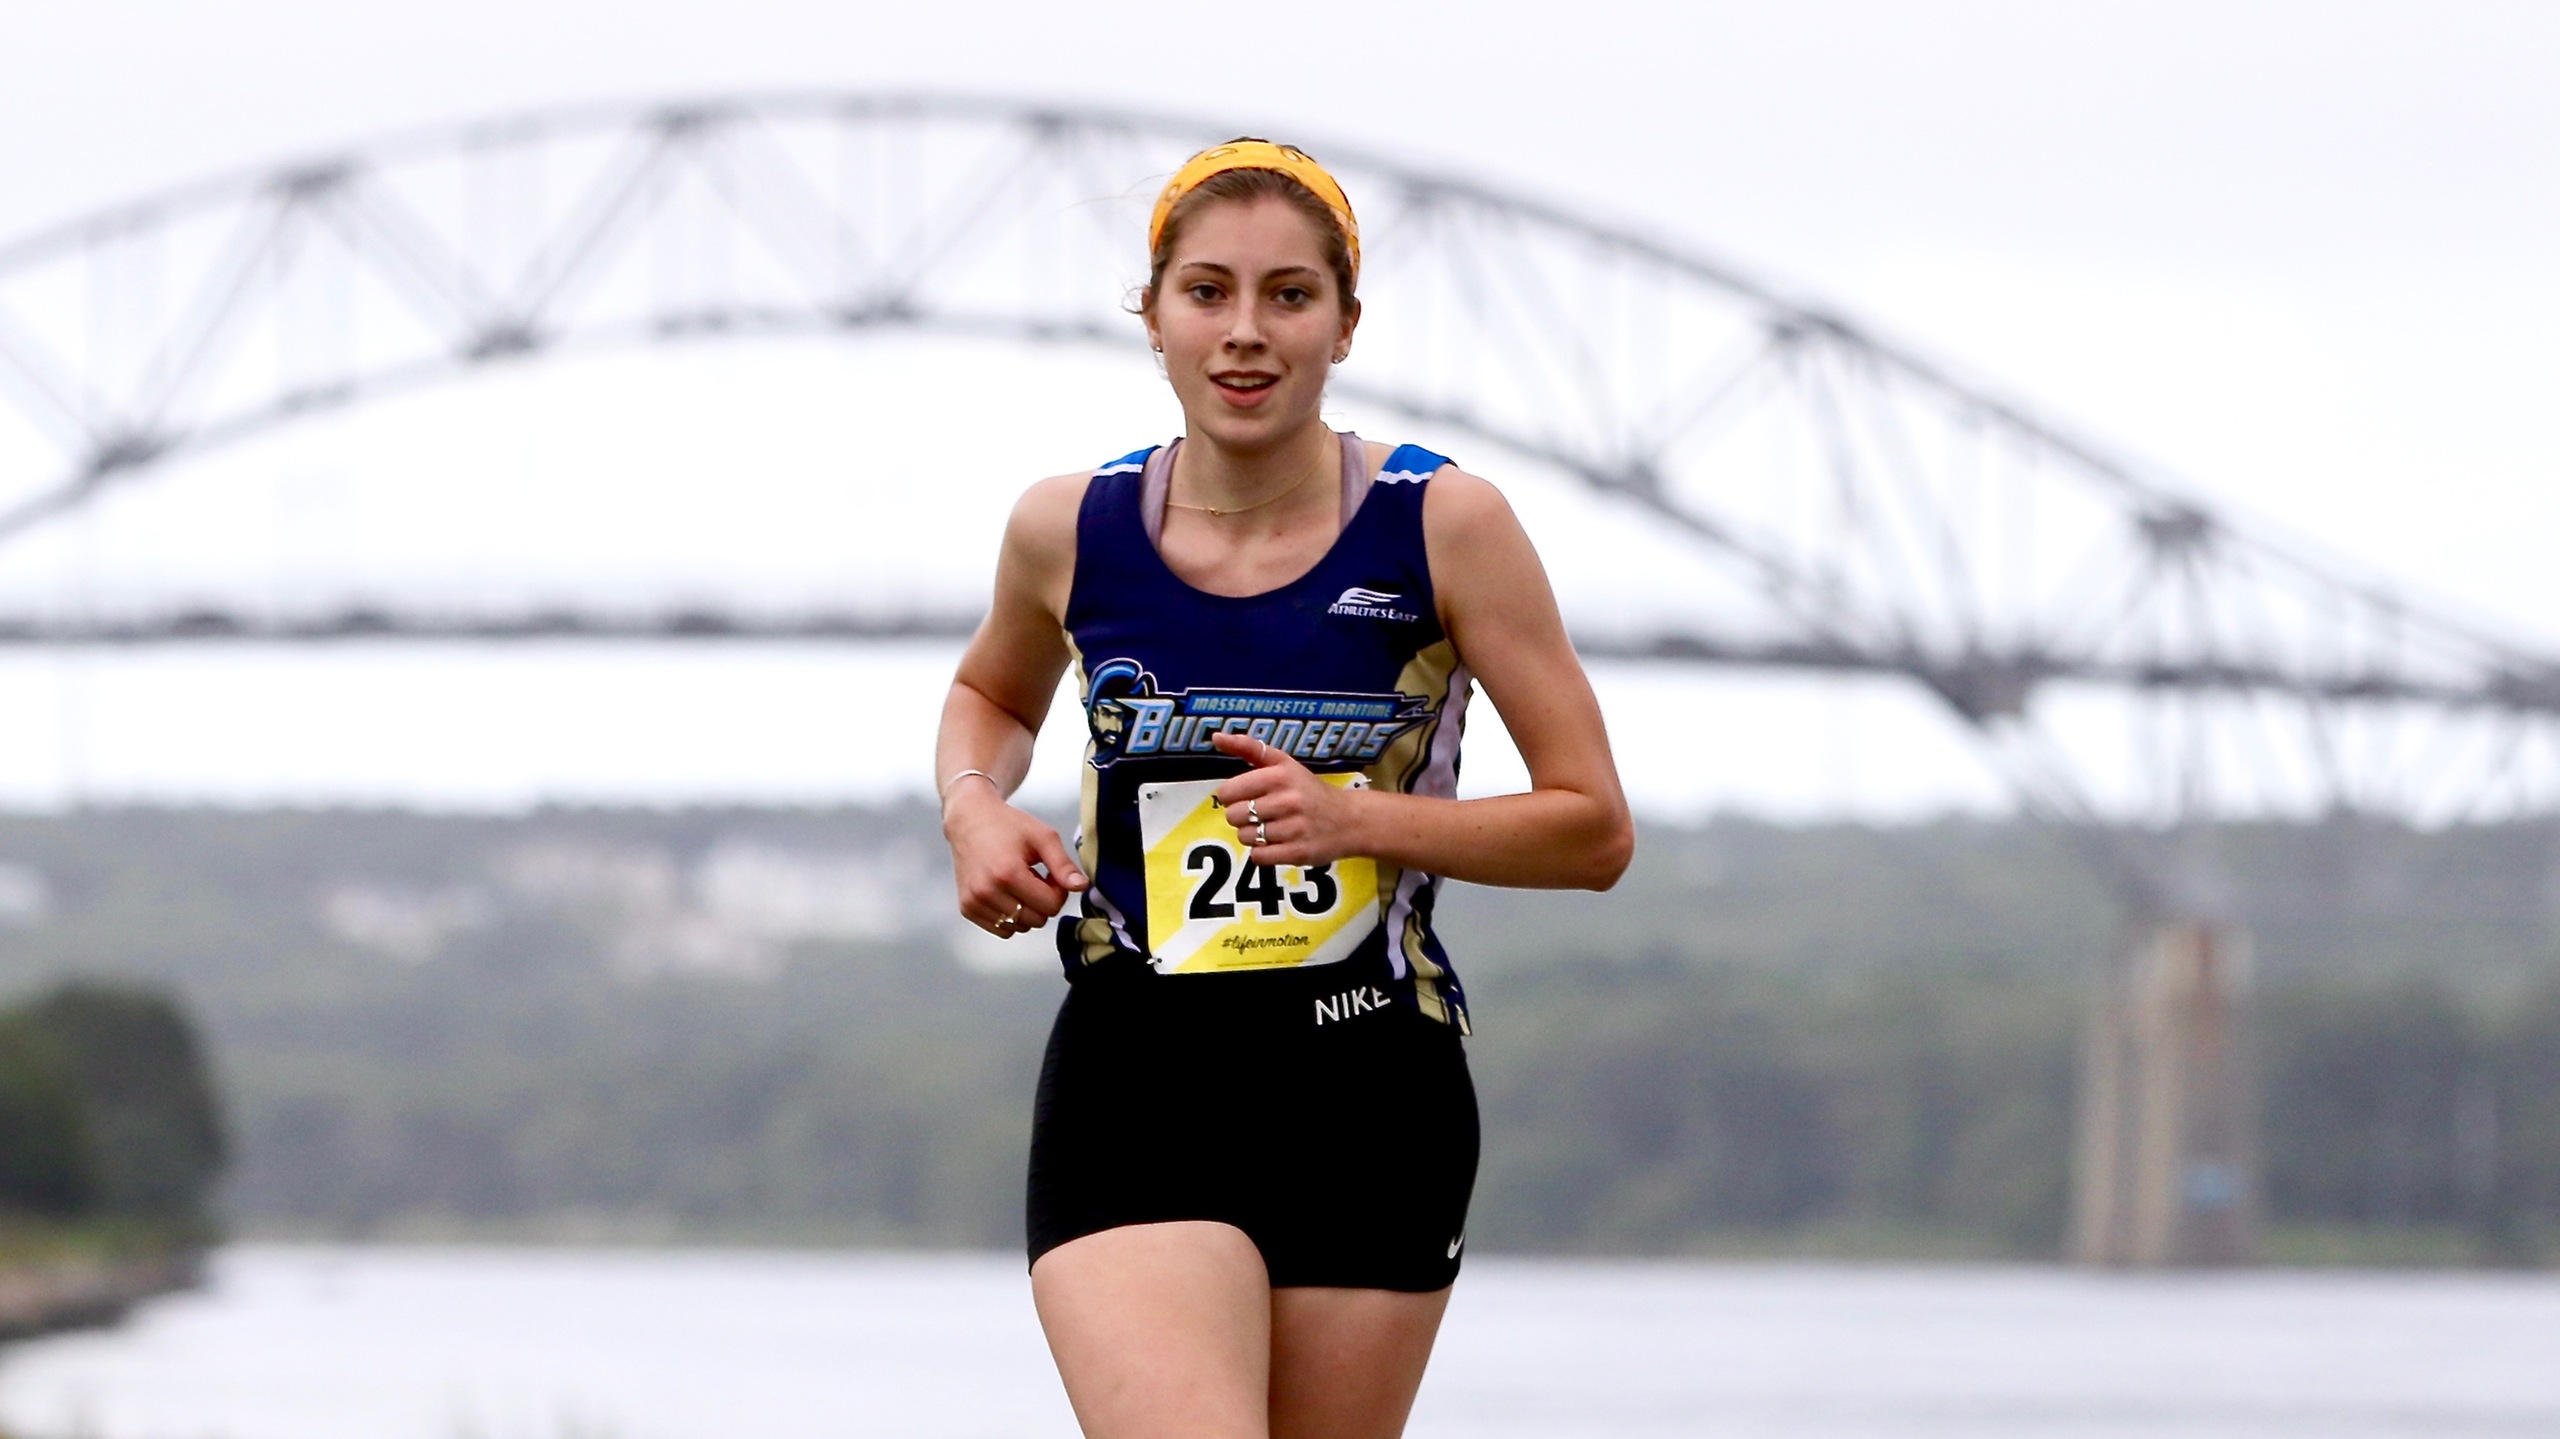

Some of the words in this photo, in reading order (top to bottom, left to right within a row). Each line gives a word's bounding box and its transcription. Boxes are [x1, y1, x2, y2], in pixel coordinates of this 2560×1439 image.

[1191, 697, 1317, 715] MASSACHUSETTS
[1319, 701, 1393, 718] MARITIME
[1186, 844, 1338, 920] 243
[1222, 934, 1310, 955] #lifeinmotion
[1315, 986, 1392, 1026] NIKE
